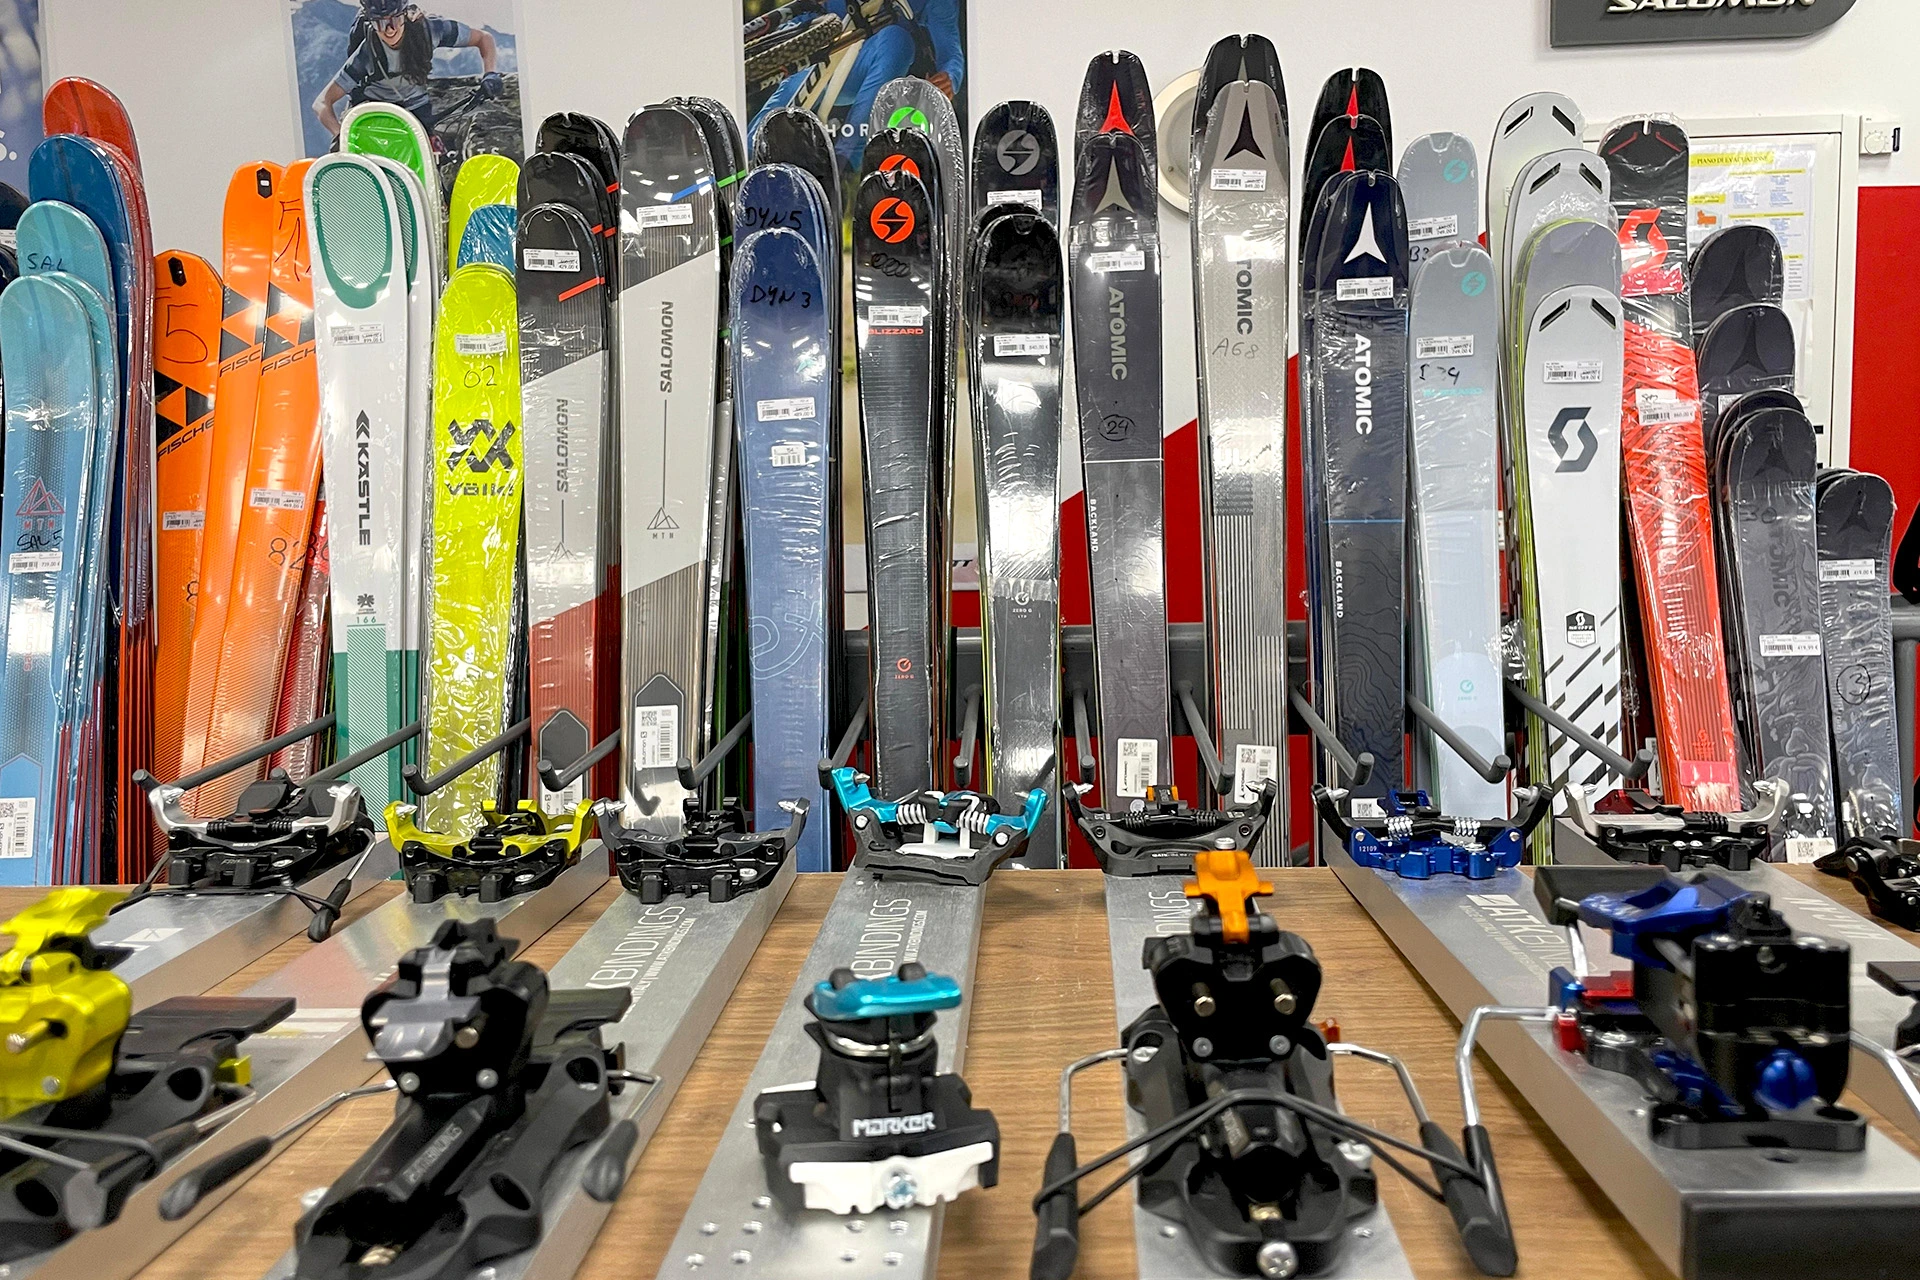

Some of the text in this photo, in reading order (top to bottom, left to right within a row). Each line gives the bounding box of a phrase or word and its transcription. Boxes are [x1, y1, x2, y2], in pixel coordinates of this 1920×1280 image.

[26, 252, 69, 272] SAL
[1236, 258, 1254, 336] TOMIC
[163, 303, 209, 364] 5
[660, 300, 674, 393] SALOMON
[1108, 286, 1129, 381] ATOMIC
[1353, 332, 1373, 436] ATOMIC
[556, 398, 569, 494] SALOMON
[652, 532, 674, 540] MTN
[1089, 498, 1100, 553] BACKLAND
[1335, 560, 1344, 619] BACKLAND
[851, 1111, 936, 1137] MARKER
